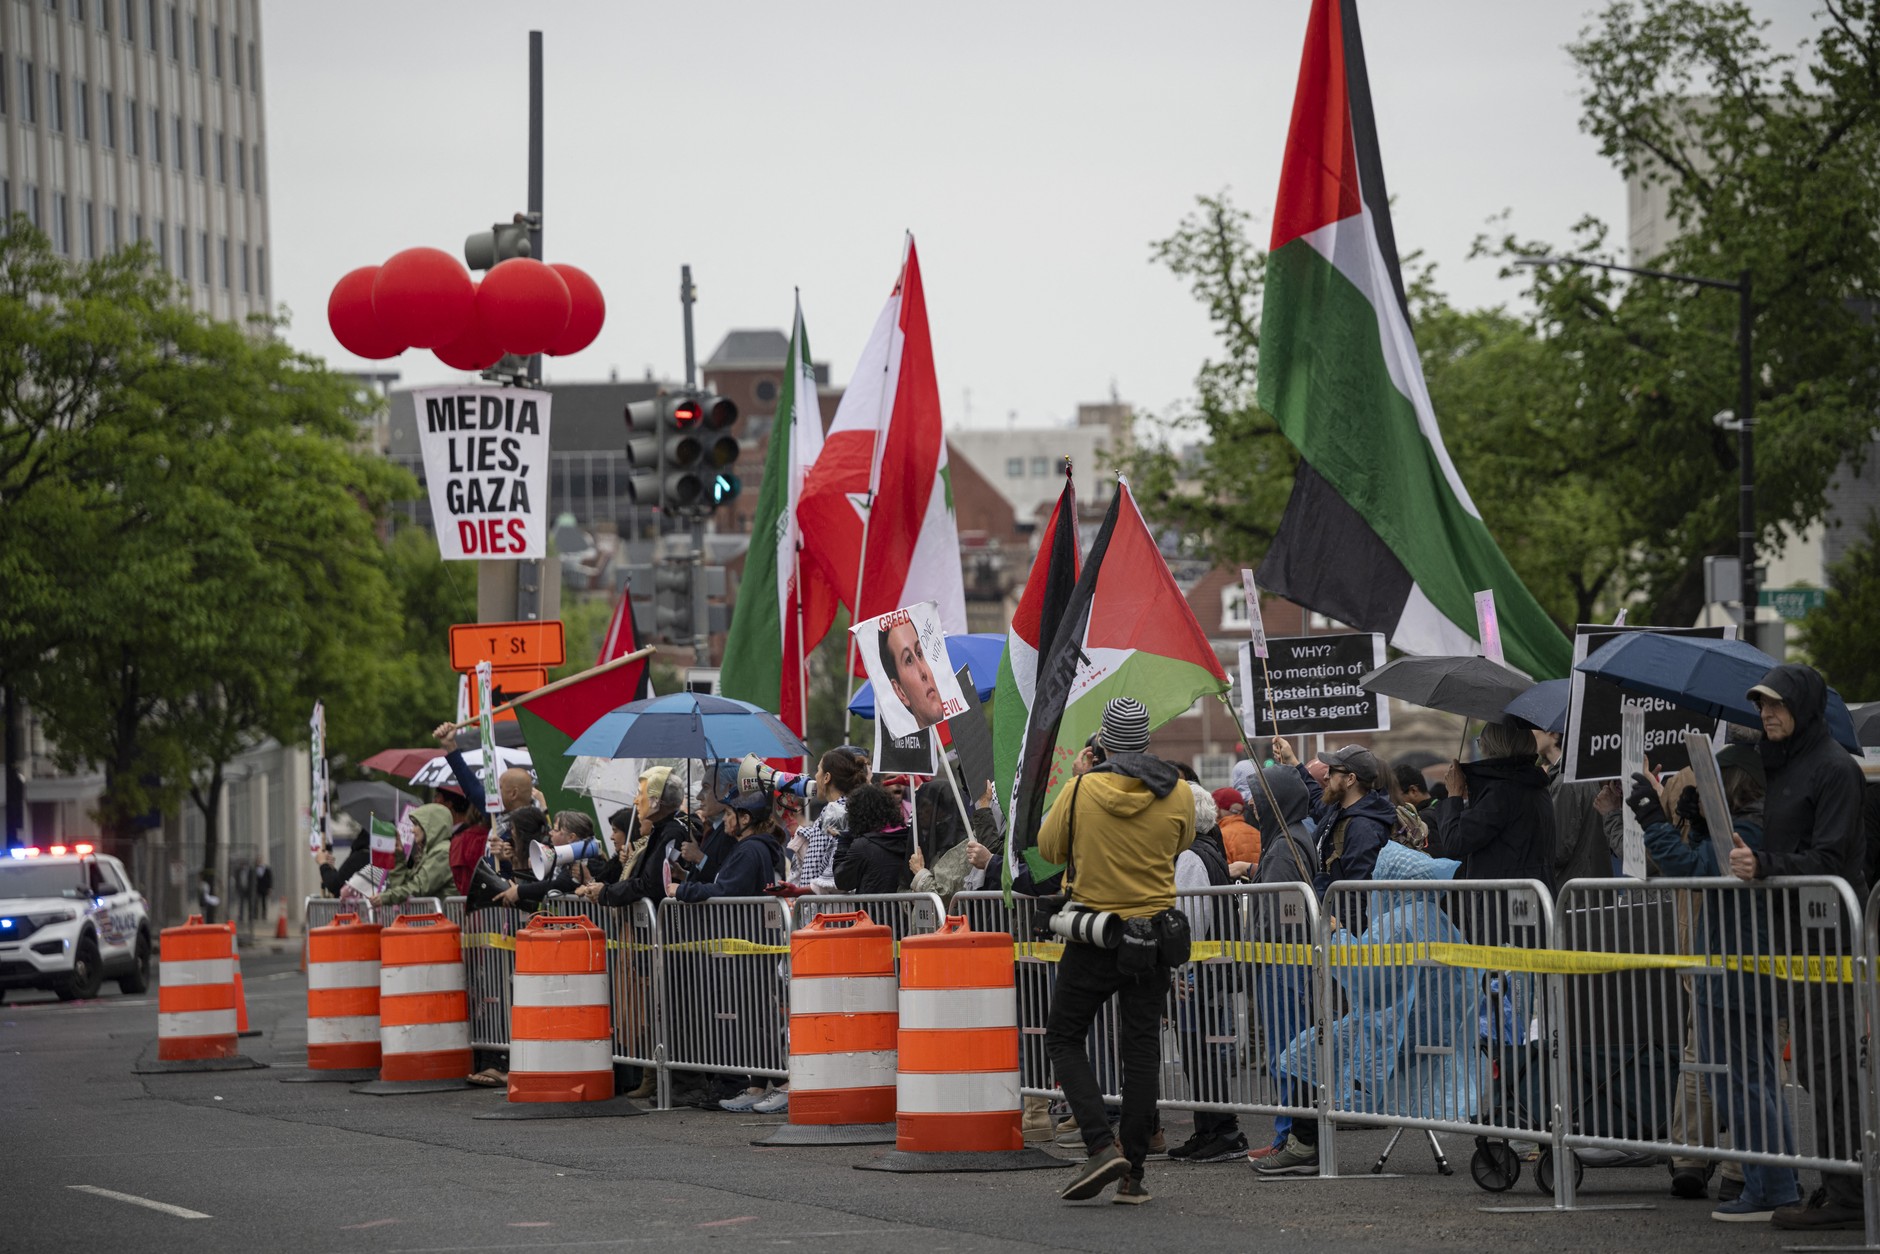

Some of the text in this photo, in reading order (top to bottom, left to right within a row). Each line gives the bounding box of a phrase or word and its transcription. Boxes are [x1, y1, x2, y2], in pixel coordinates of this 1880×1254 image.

[426, 395, 540, 435] MEDIA
[448, 436, 530, 478] LIES,
[446, 476, 532, 515] GAZA
[458, 518, 527, 555] DIES
[878, 609, 911, 632] GREED
[920, 618, 935, 650] DINE
[489, 637, 527, 655] T St
[932, 637, 943, 663] WITH
[1291, 644, 1332, 659] WHY?
[1266, 661, 1363, 681] no mention of
[1264, 682, 1365, 701] Epstein being
[942, 697, 963, 718] EVIL
[1262, 701, 1370, 721] Israel's agent?
[905, 736, 921, 749] META
[1590, 723, 1701, 757] progand
[1284, 903, 1297, 917] GRE
[1512, 897, 1529, 918] GRE
[1807, 900, 1828, 919] GRE
[1317, 1018, 1325, 1046] GRE
[1552, 1029, 1560, 1059] GRE
[1859, 1035, 1869, 1069] GRE
